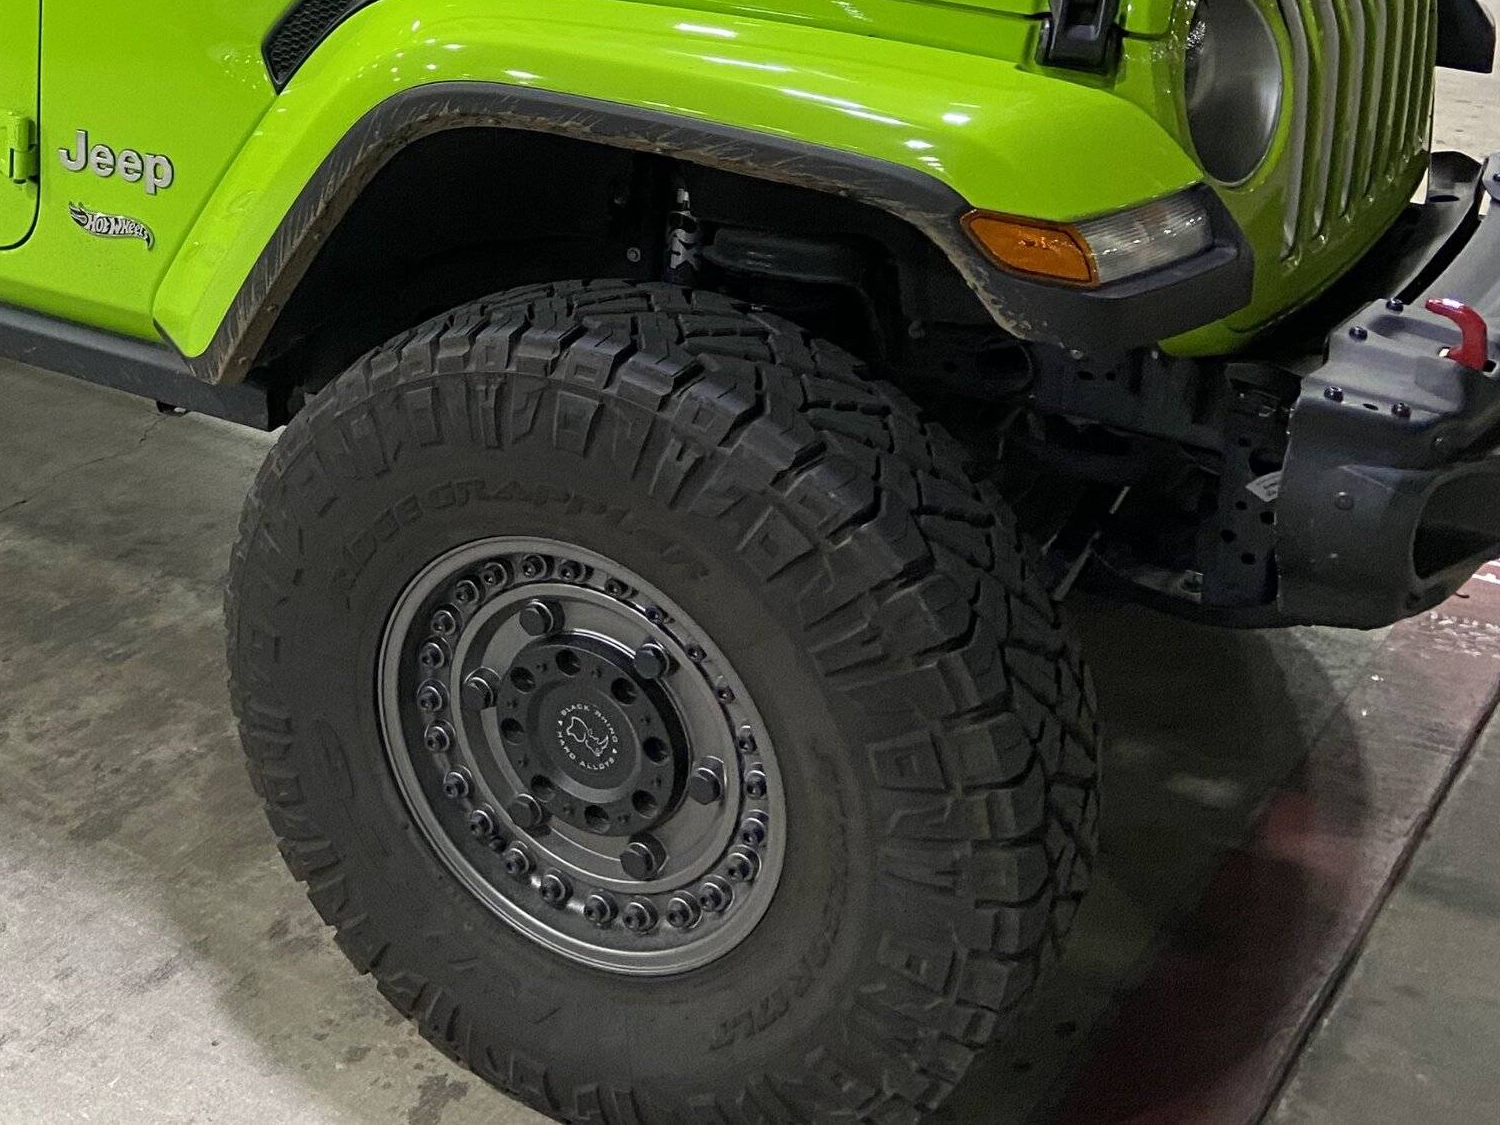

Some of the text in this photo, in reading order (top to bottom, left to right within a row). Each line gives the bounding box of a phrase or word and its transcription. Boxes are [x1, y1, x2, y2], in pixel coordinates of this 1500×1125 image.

[57, 128, 175, 196] Jeep
[560, 703, 619, 743] BLACK RHINO
